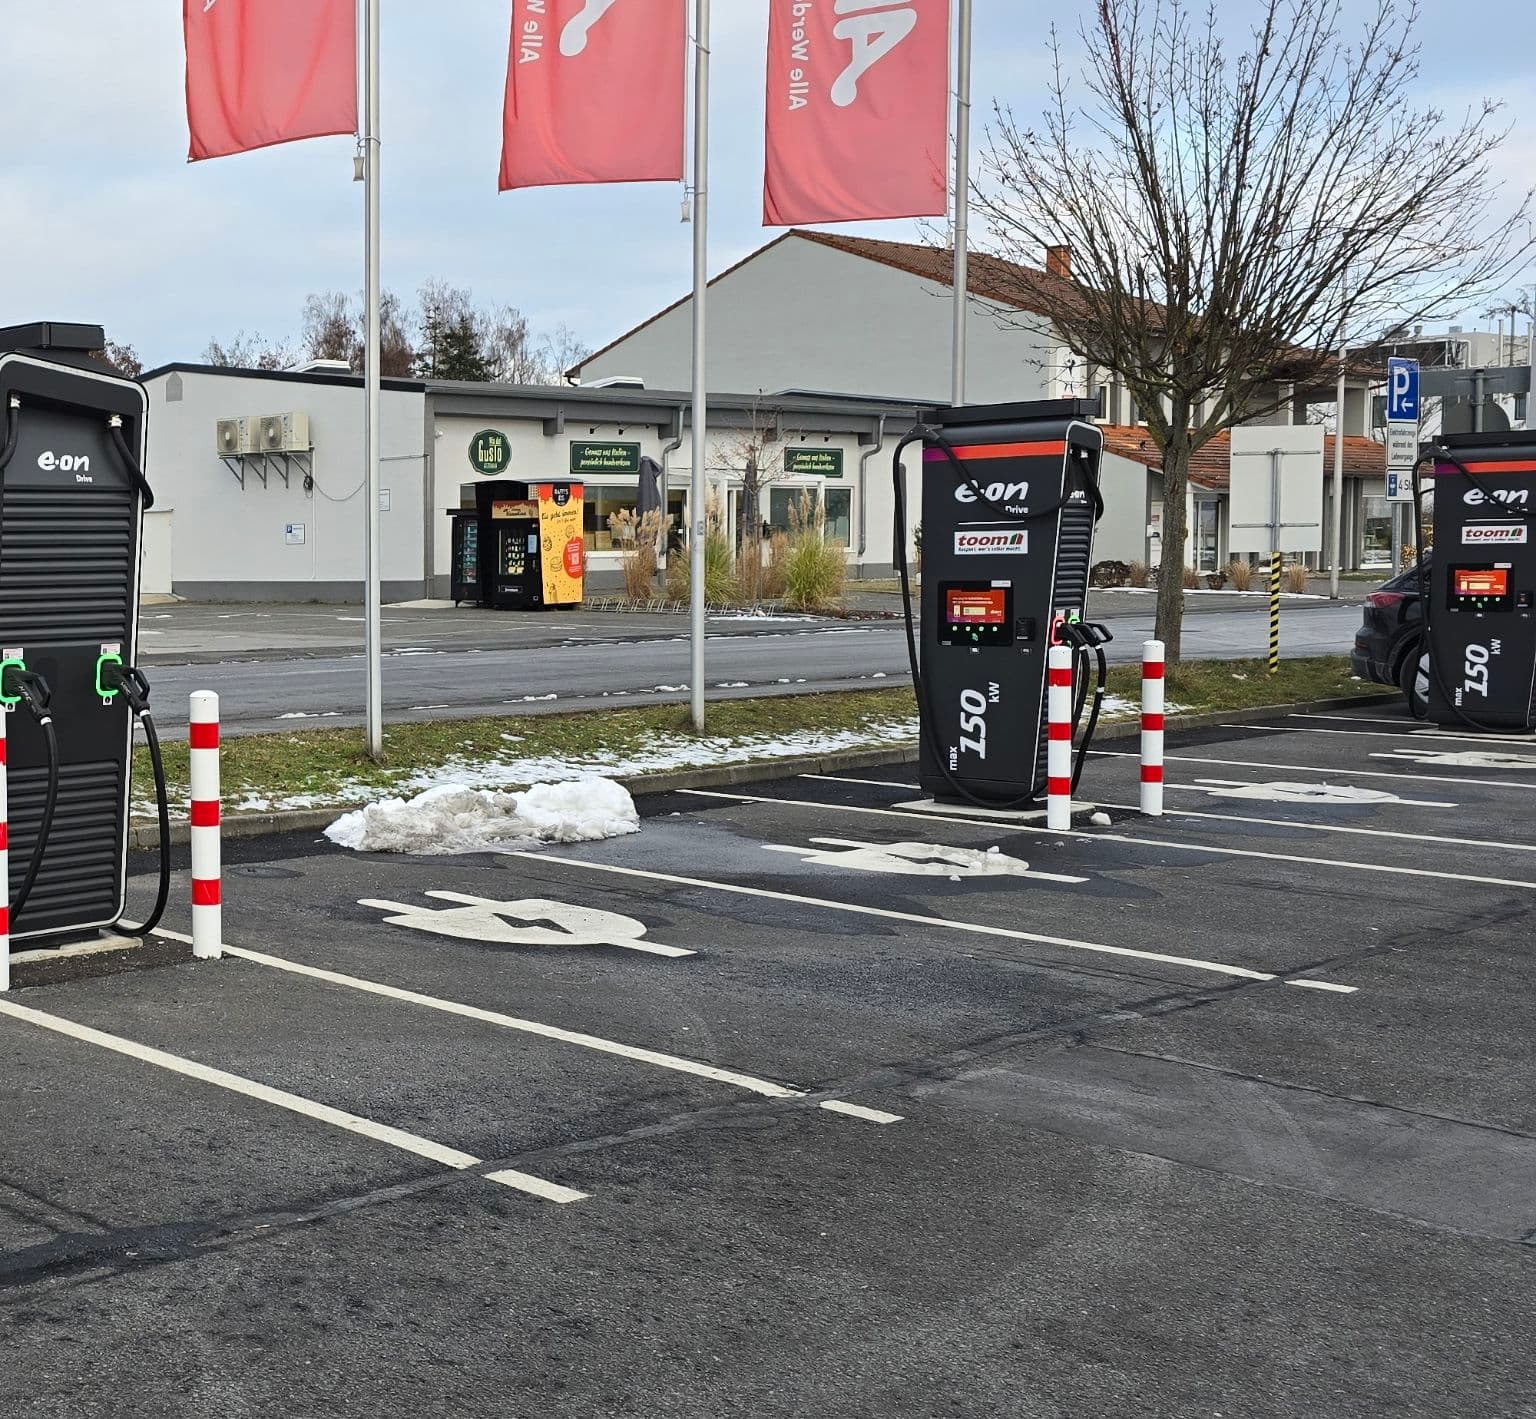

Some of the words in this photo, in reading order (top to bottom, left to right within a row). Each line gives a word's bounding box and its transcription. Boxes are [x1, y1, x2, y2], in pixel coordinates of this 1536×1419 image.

[1393, 366, 1410, 412] P
[958, 535, 1009, 546] toom
[1466, 529, 1510, 538] toom
[1464, 643, 1489, 697] 150
[1455, 687, 1463, 706] max
[960, 689, 987, 759] 150
[949, 746, 958, 771] max
